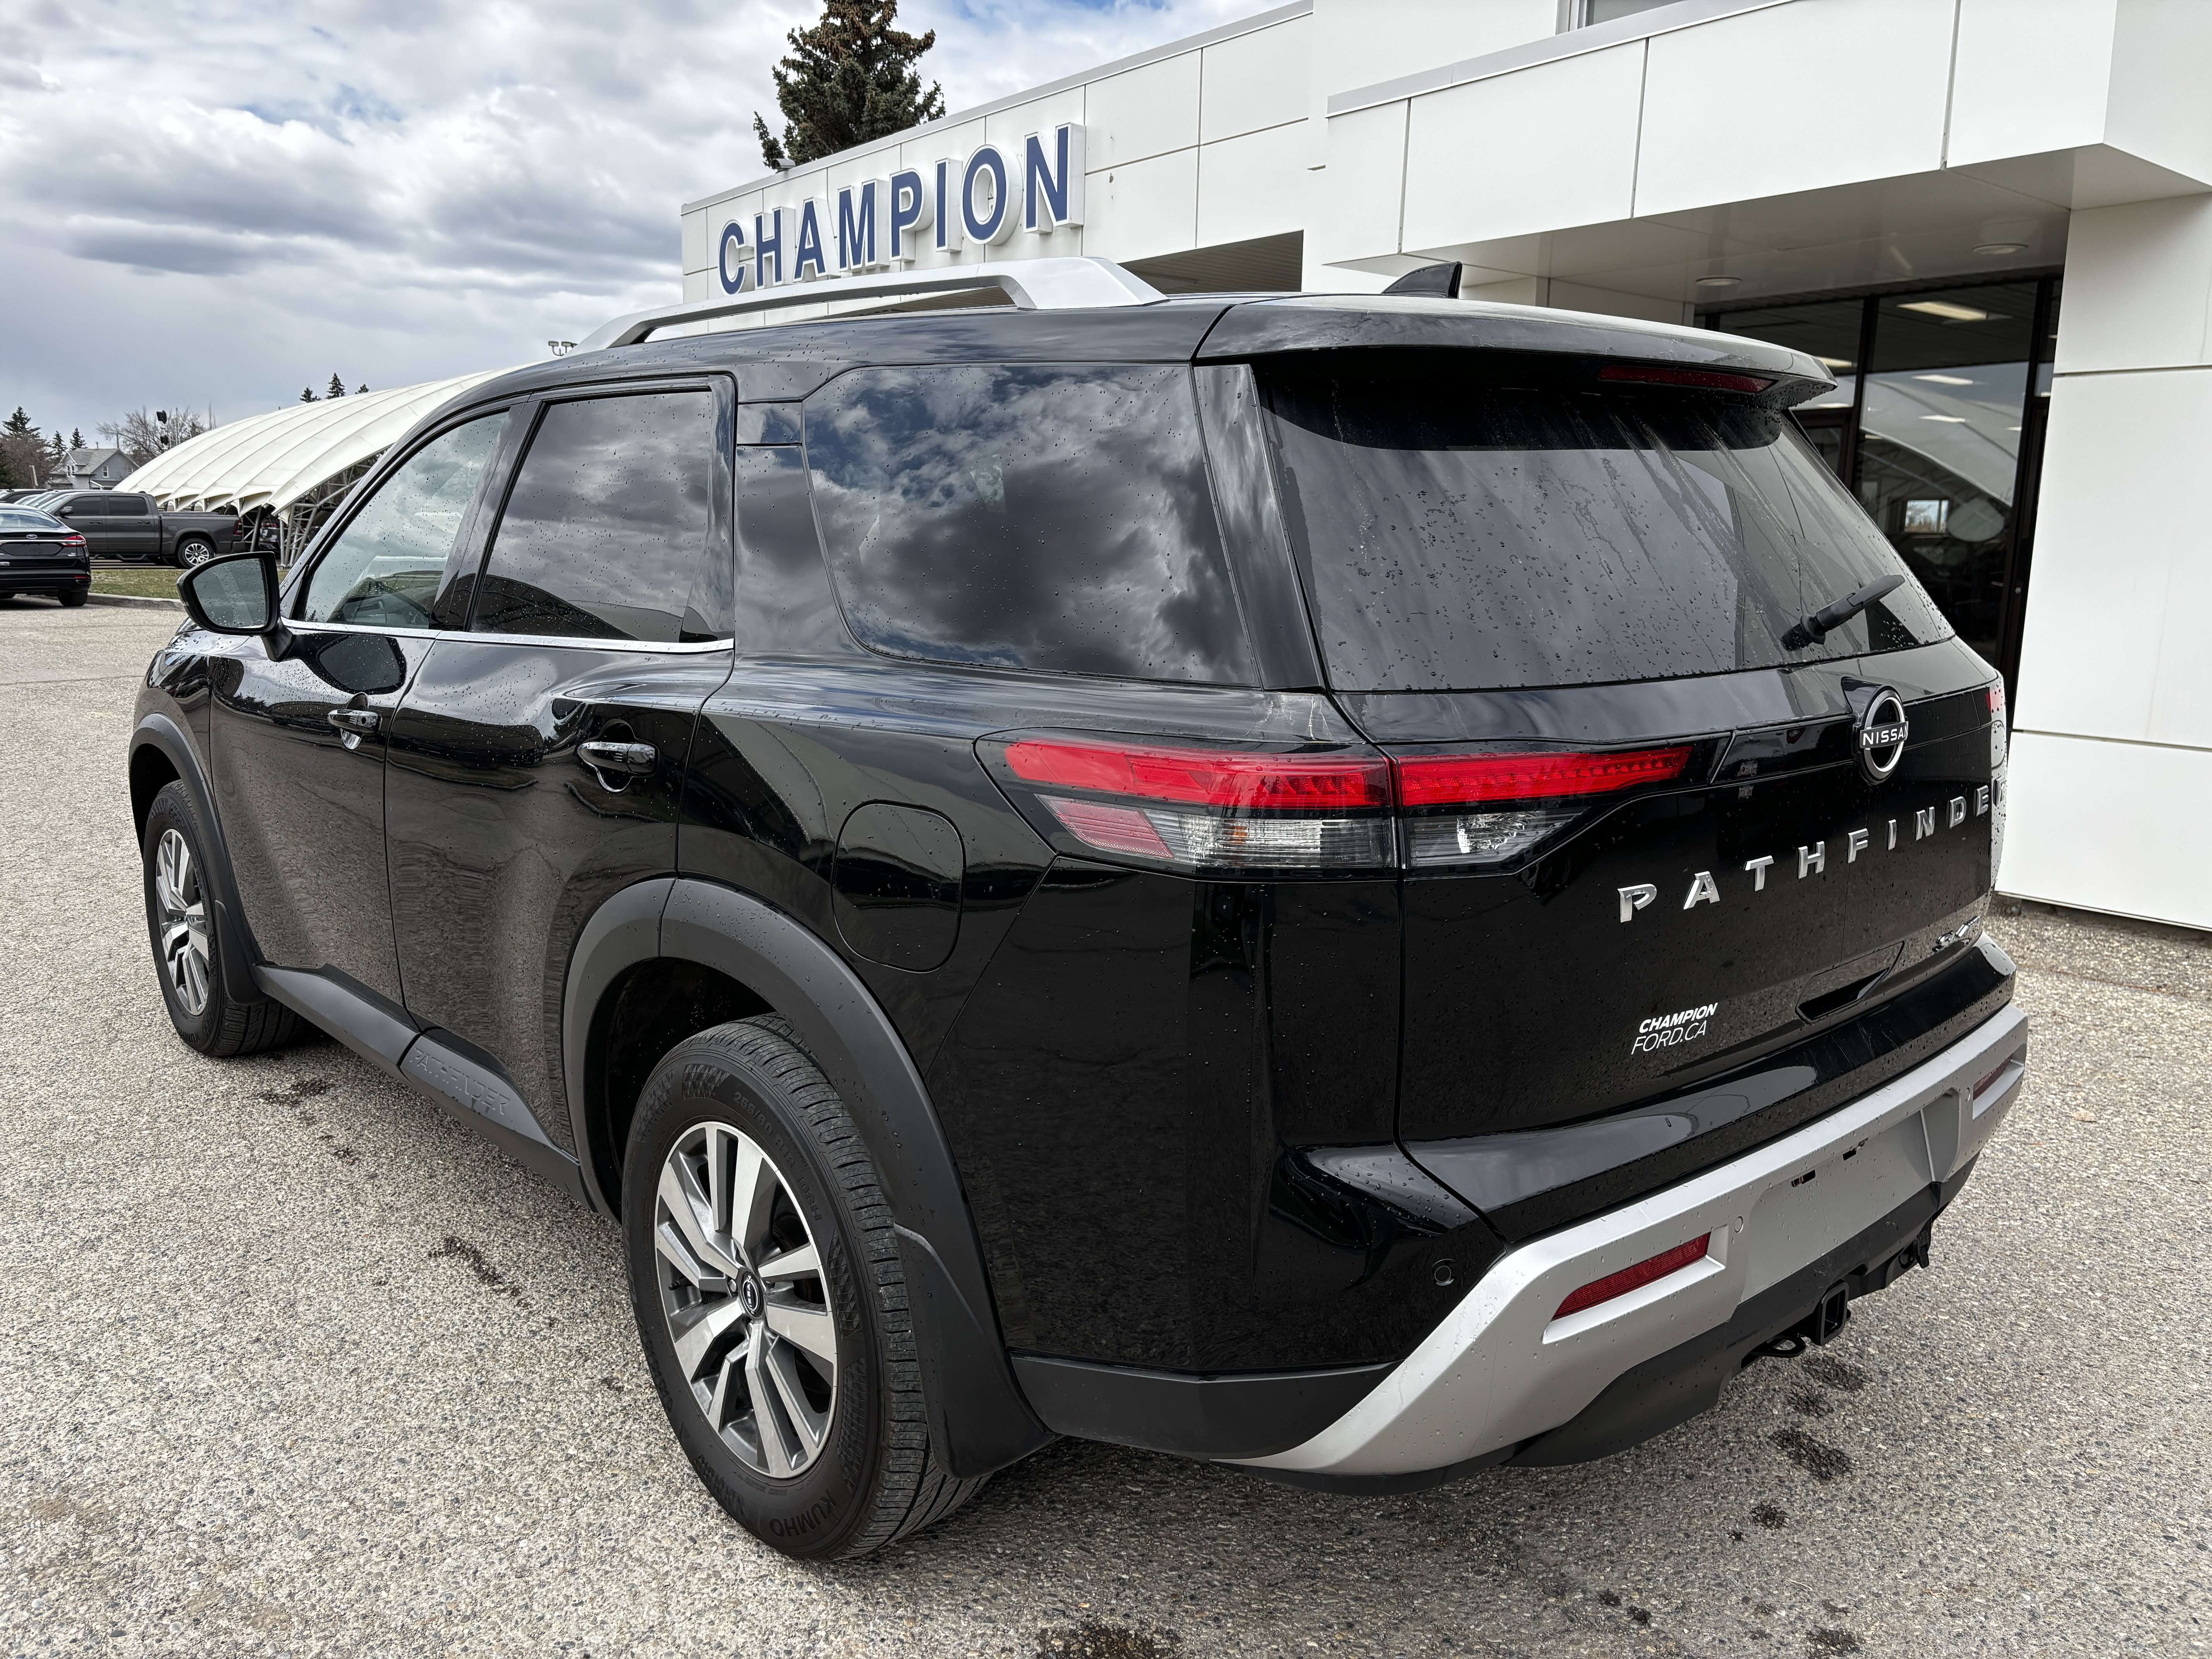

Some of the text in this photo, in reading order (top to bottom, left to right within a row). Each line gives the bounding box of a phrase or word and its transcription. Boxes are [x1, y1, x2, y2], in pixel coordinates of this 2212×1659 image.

[718, 123, 1071, 295] CHAMPION
[1863, 724, 1908, 746] NISSAN
[1639, 1002, 1718, 1033] CHAMPION
[1631, 1020, 1707, 1054] FORD.CA
[769, 1489, 836, 1537] KUMHO
